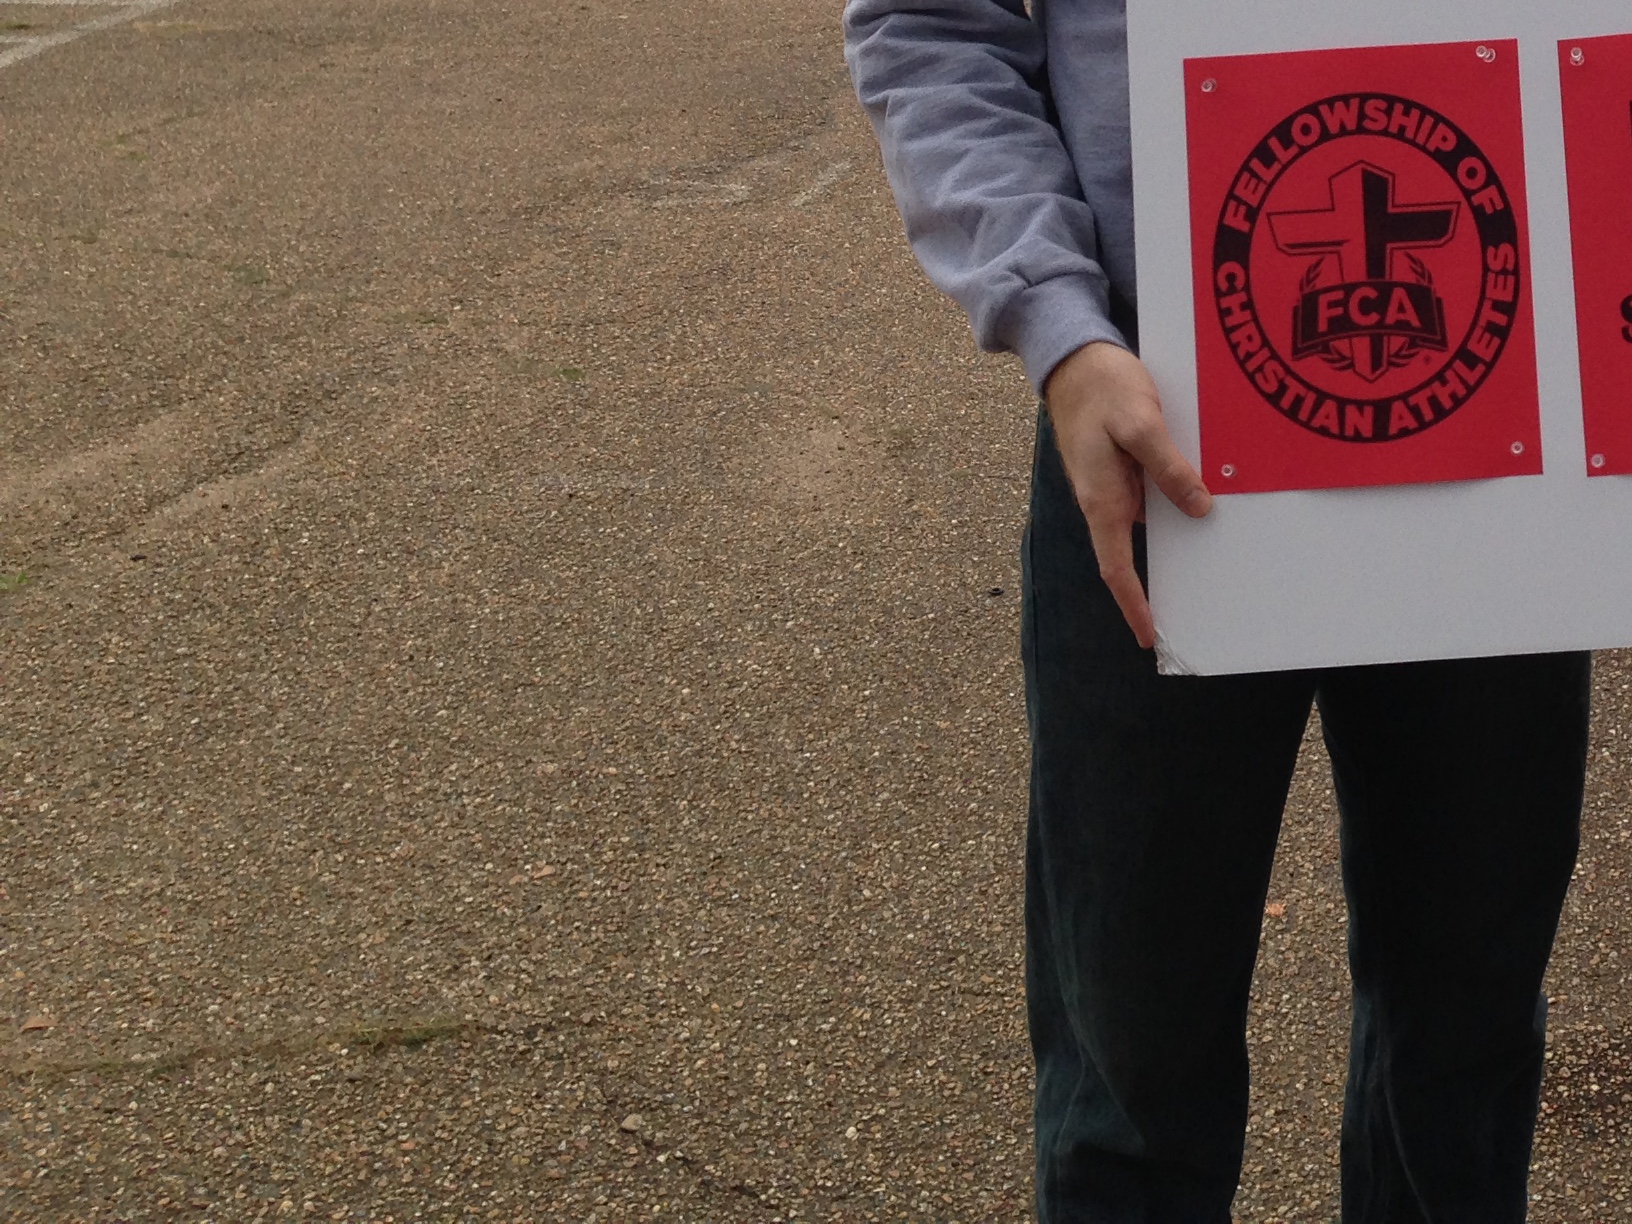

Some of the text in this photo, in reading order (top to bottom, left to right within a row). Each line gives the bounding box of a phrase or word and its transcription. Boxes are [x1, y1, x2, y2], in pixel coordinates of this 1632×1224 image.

[1224, 98, 1505, 233] FELLOWSHIP OF
[1217, 242, 1515, 439] CHRISTIAN ATHLETES
[1317, 286, 1421, 332] FCA
